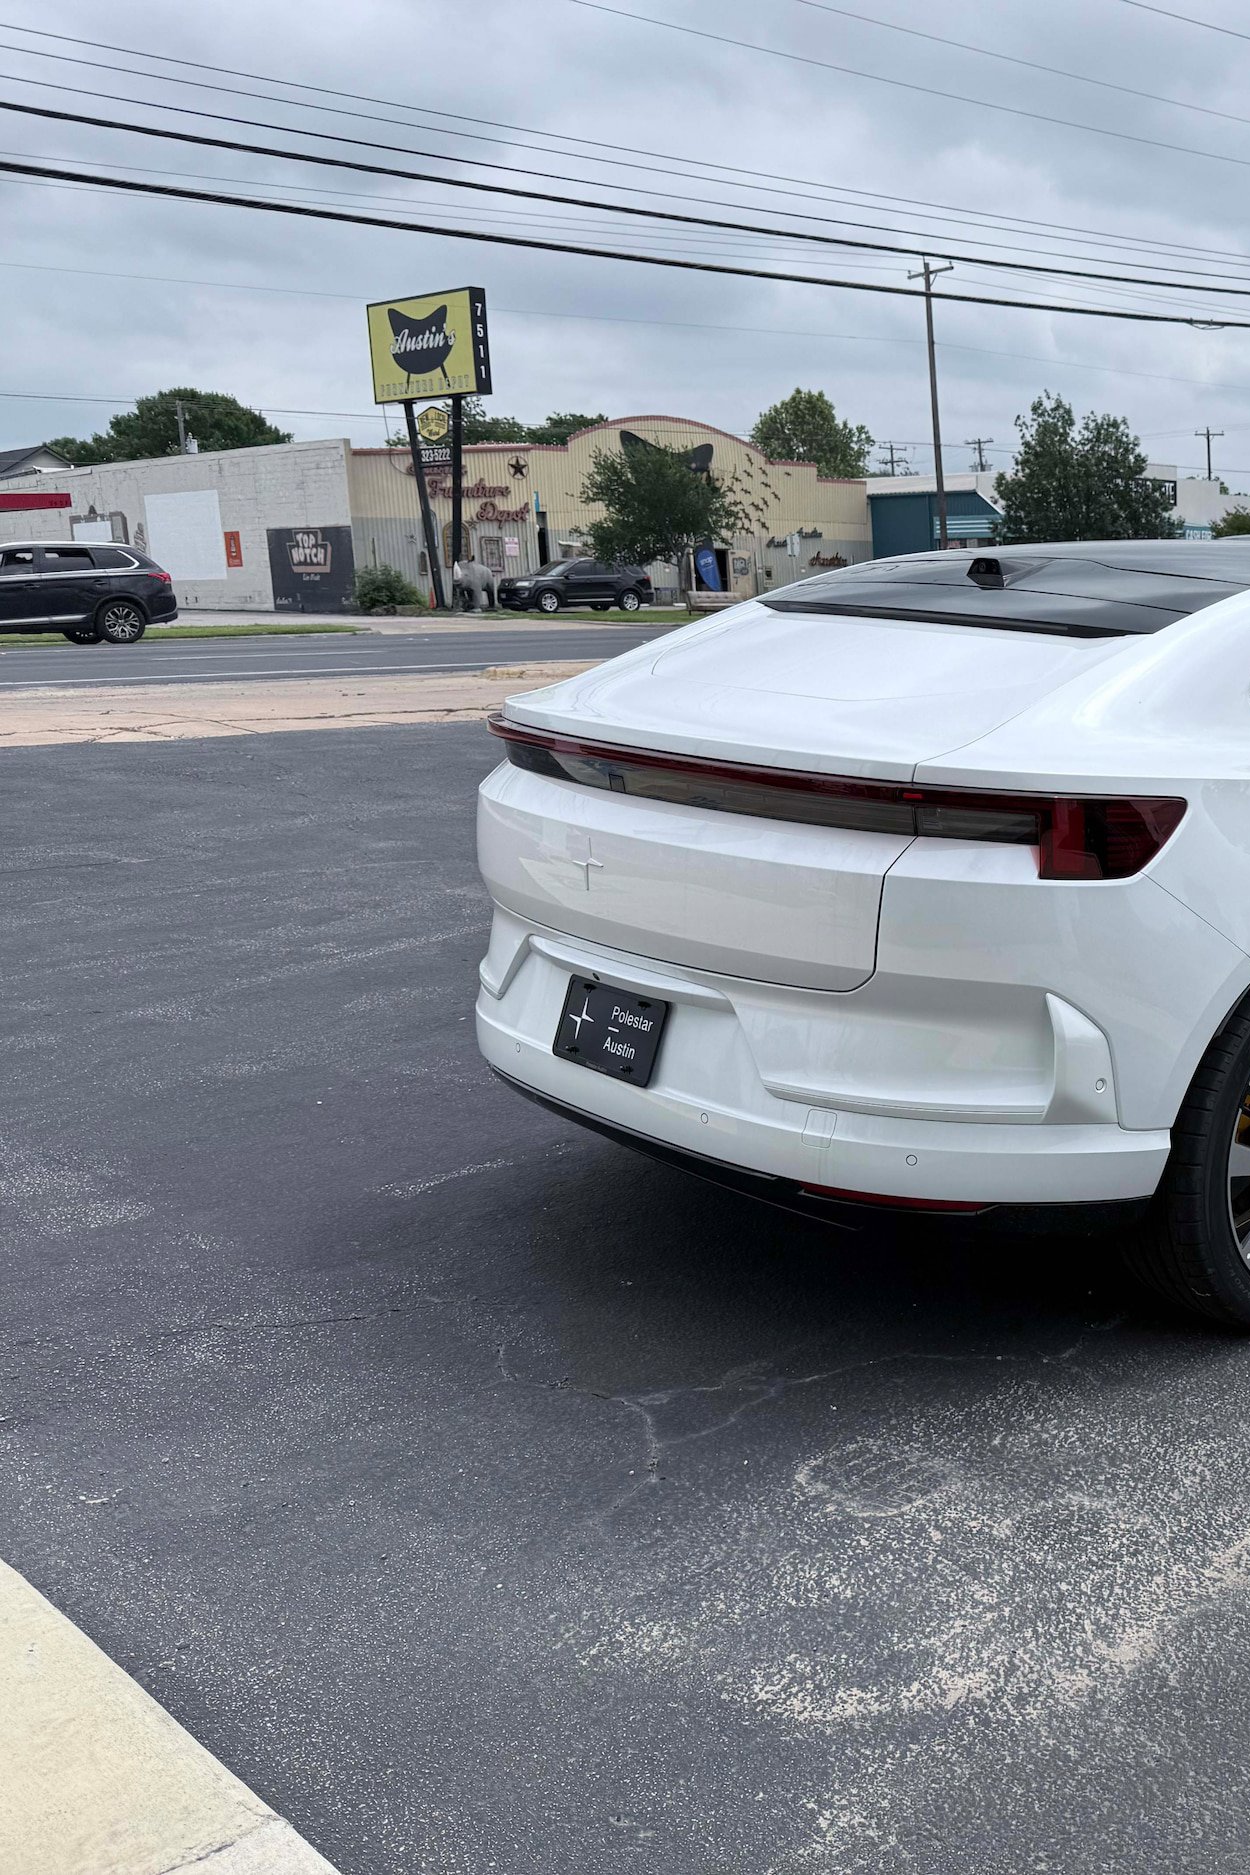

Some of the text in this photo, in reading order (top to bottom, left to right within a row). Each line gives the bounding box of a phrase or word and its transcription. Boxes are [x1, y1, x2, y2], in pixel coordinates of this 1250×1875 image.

[390, 323, 456, 354] Austin's
[474, 302, 487, 379] 7511
[476, 501, 530, 529] Depot
[295, 532, 316, 548] TOP
[291, 547, 325, 565] NOTCH
[611, 1006, 653, 1033] Polestar
[602, 1036, 636, 1060] Austin
